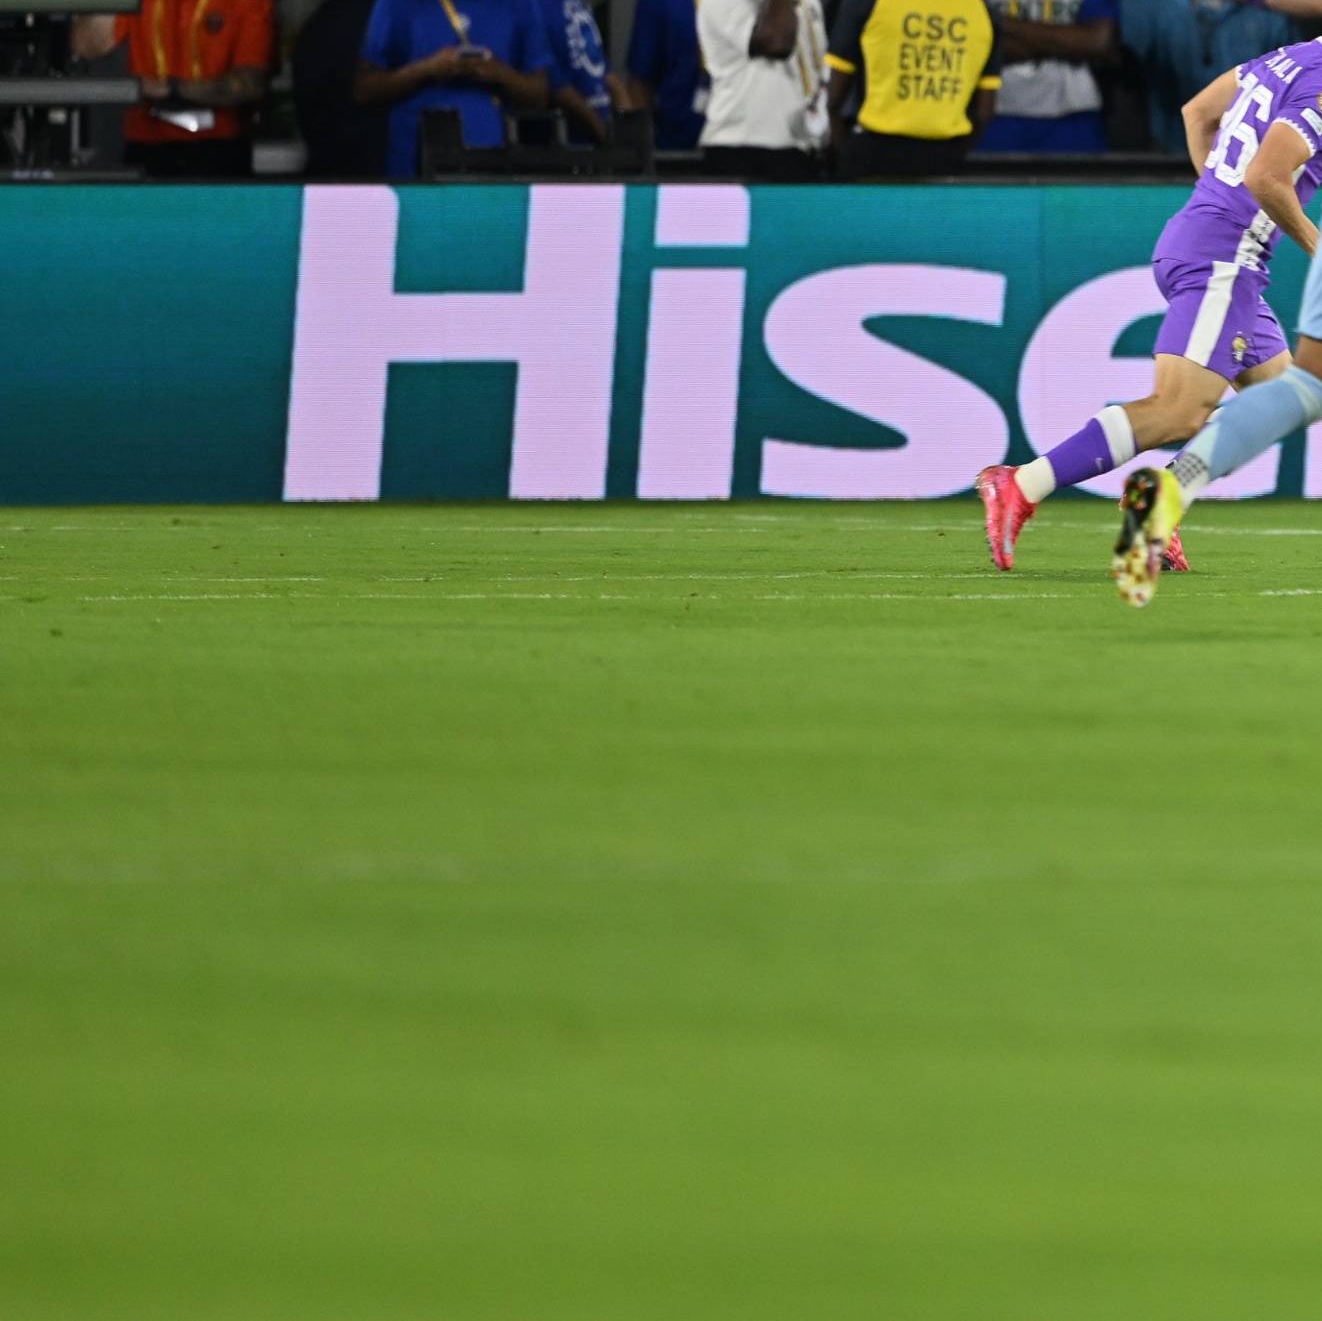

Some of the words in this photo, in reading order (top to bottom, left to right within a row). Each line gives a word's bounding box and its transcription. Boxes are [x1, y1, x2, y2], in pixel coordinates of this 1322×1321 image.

[902, 12, 967, 44] CSC
[899, 42, 965, 71] EVENT
[897, 73, 963, 102] STAFF
[1204, 72, 1274, 188] 16
